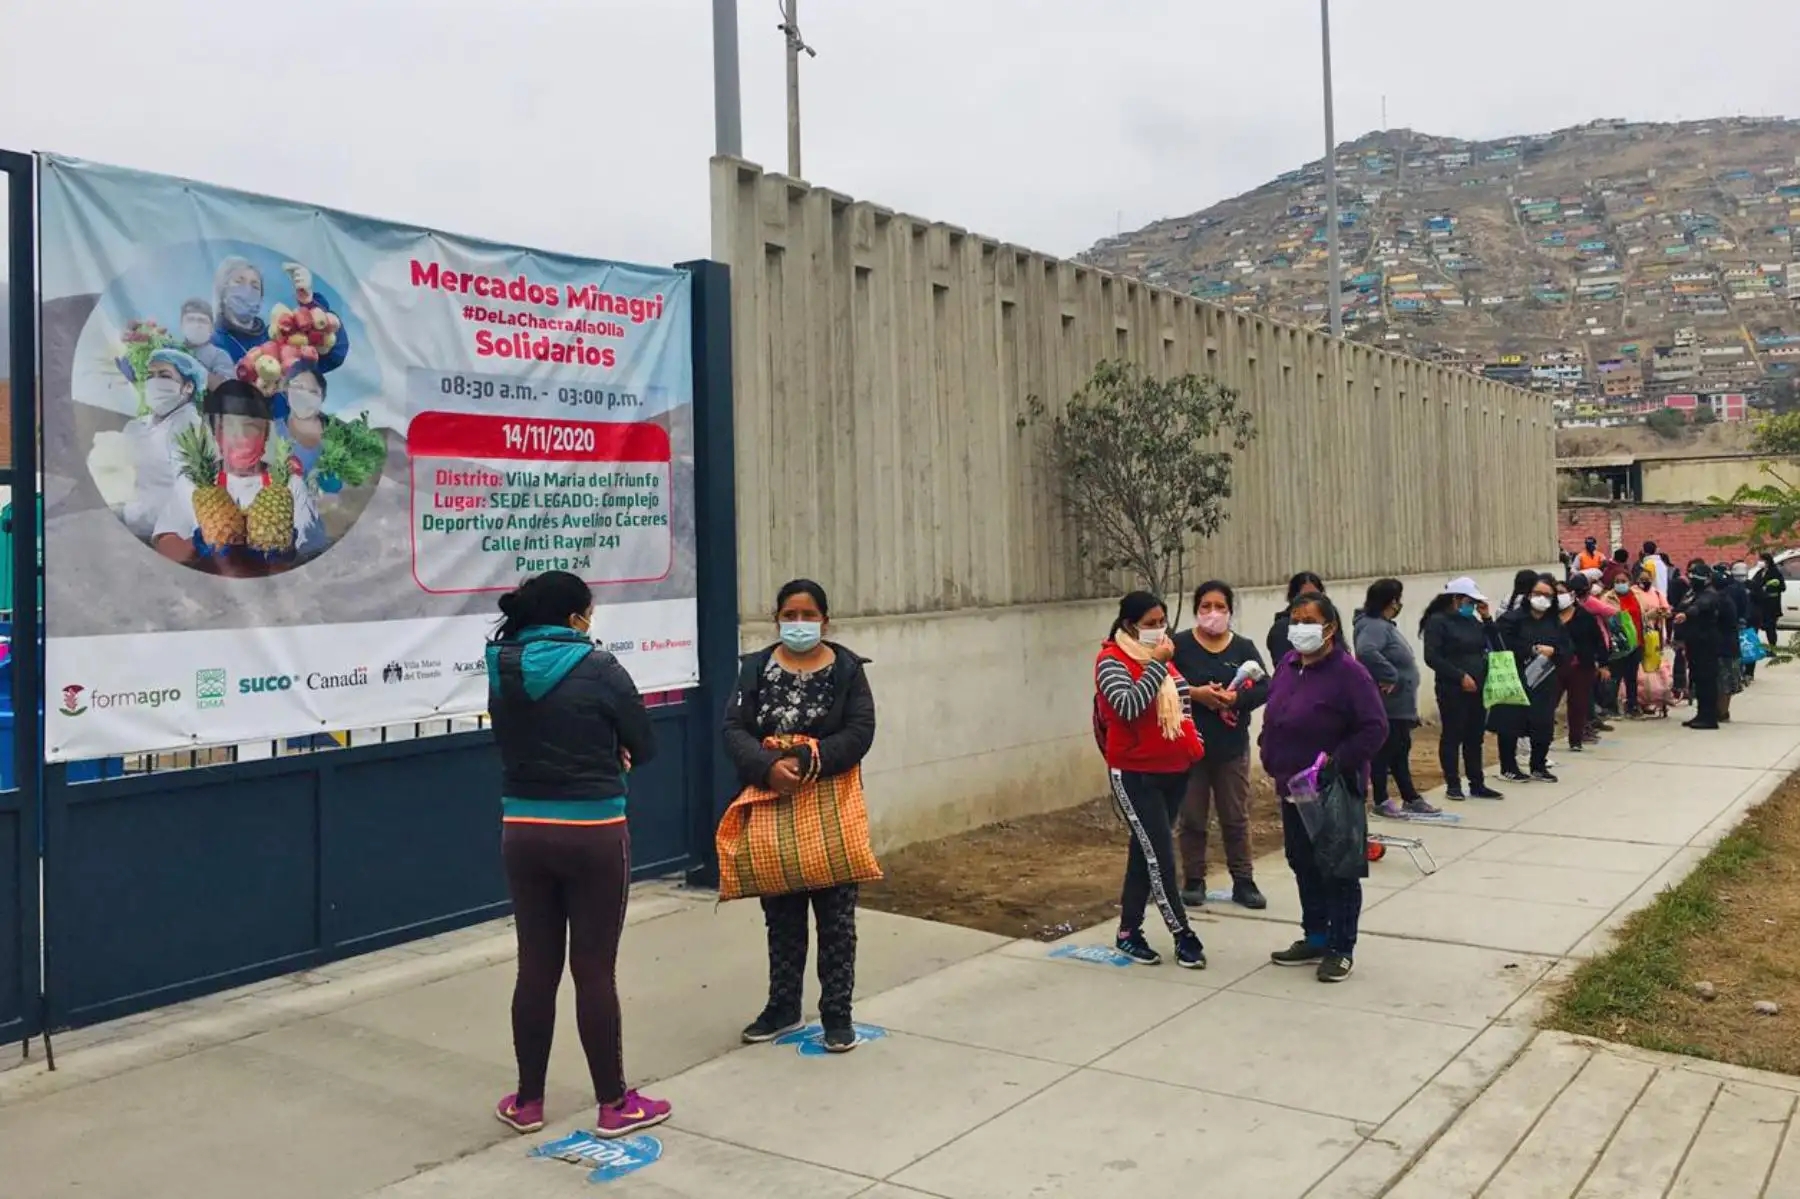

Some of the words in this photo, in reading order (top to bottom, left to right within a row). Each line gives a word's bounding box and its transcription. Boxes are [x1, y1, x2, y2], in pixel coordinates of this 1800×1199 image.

[410, 260, 560, 306] Mercados
[566, 285, 665, 323] Minagri
[463, 305, 625, 337] #DeLaChacraAlaOlla
[475, 330, 616, 367] Solidarios
[441, 377, 494, 399] 08:30
[500, 385, 538, 400] a.m.
[558, 388, 604, 405] 03:00
[607, 391, 644, 409] p.m.
[502, 424, 596, 453] 14/11/2020
[435, 470, 503, 487] Distrito:
[506, 472, 540, 488] Villa
[544, 473, 585, 488] Maria
[588, 473, 612, 487] del
[614, 472, 659, 488] Triunfo
[434, 493, 486, 512] Lugar:
[490, 493, 530, 508] SEDE
[534, 493, 599, 508] LEGADO:
[601, 492, 659, 511] Complejo
[422, 514, 504, 534] Deportivo
[507, 514, 558, 530] Andrés
[562, 512, 612, 528] Avelino
[615, 510, 668, 527] Cáceres
[481, 536, 520, 552] Calle
[523, 534, 550, 551] Inti
[553, 533, 596, 553] Raymi
[598, 534, 620, 549] 241
[516, 554, 569, 571] Puerta
[572, 554, 591, 569] 2-A
[239, 675, 292, 694] suco
[91, 688, 182, 709] formagro
